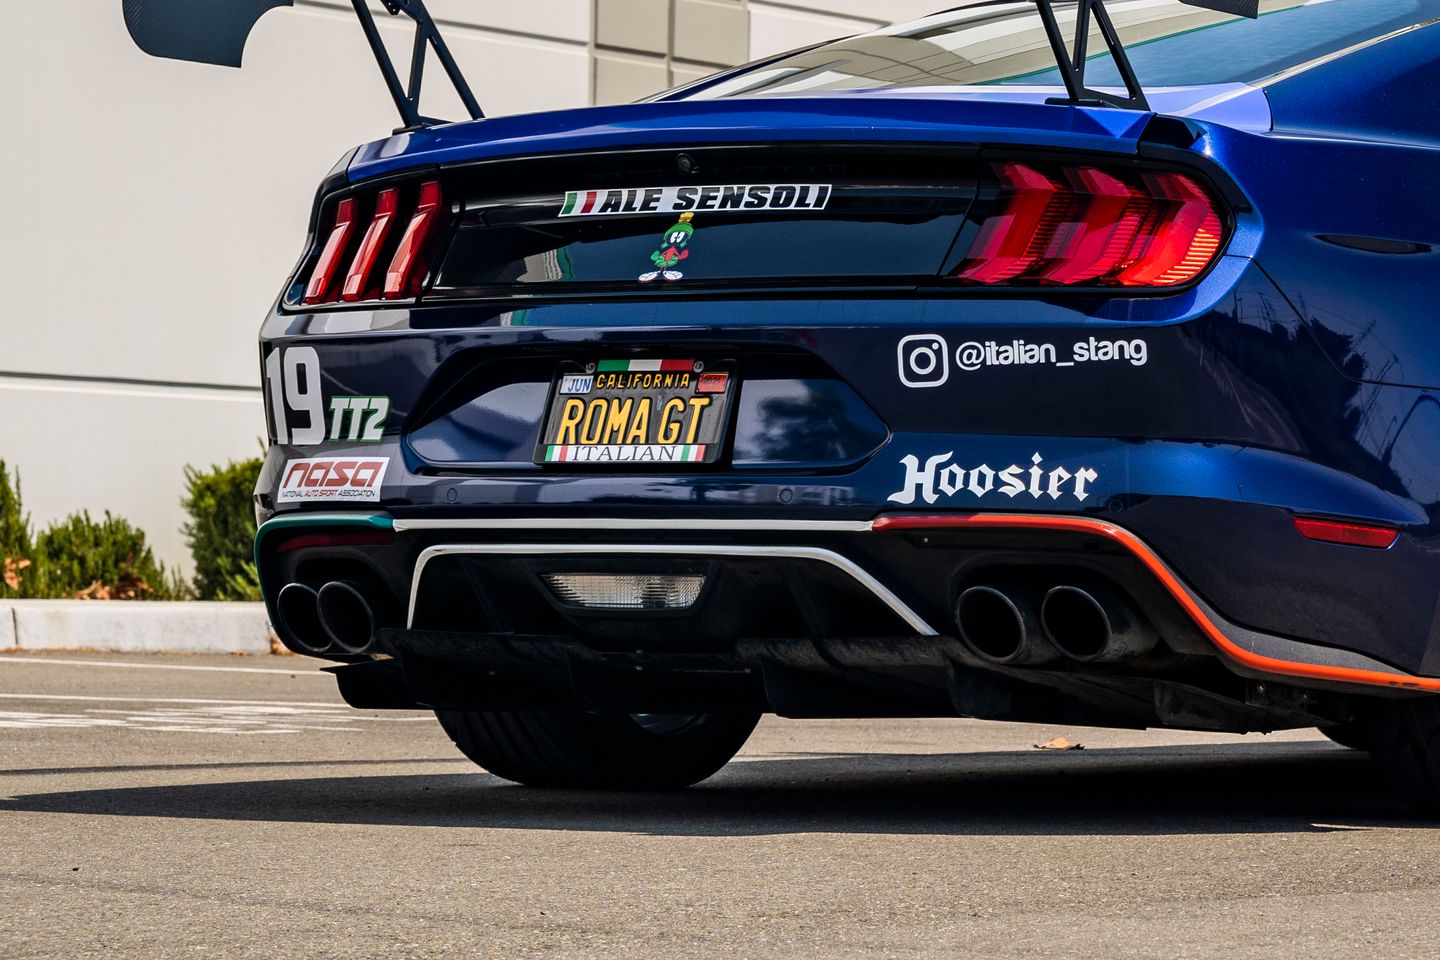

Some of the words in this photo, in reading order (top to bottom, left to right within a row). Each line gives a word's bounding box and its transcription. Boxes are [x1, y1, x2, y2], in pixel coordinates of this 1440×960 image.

[598, 188, 663, 214] ALE
[671, 185, 824, 211] SENSOLI
[955, 336, 1148, 371] @italian_stang
[265, 346, 326, 445] 19
[567, 378, 592, 392] JUN
[596, 373, 690, 389] CALIFORNIA
[328, 395, 390, 442] TT2
[556, 398, 651, 445] ROMA
[657, 396, 711, 445] GT
[572, 445, 678, 461] ITALIAN
[304, 490, 319, 498] AUTO
[319, 489, 338, 497] SPORT
[337, 489, 376, 498] ASSOCIATION
[886, 450, 1099, 505] Hoosier
